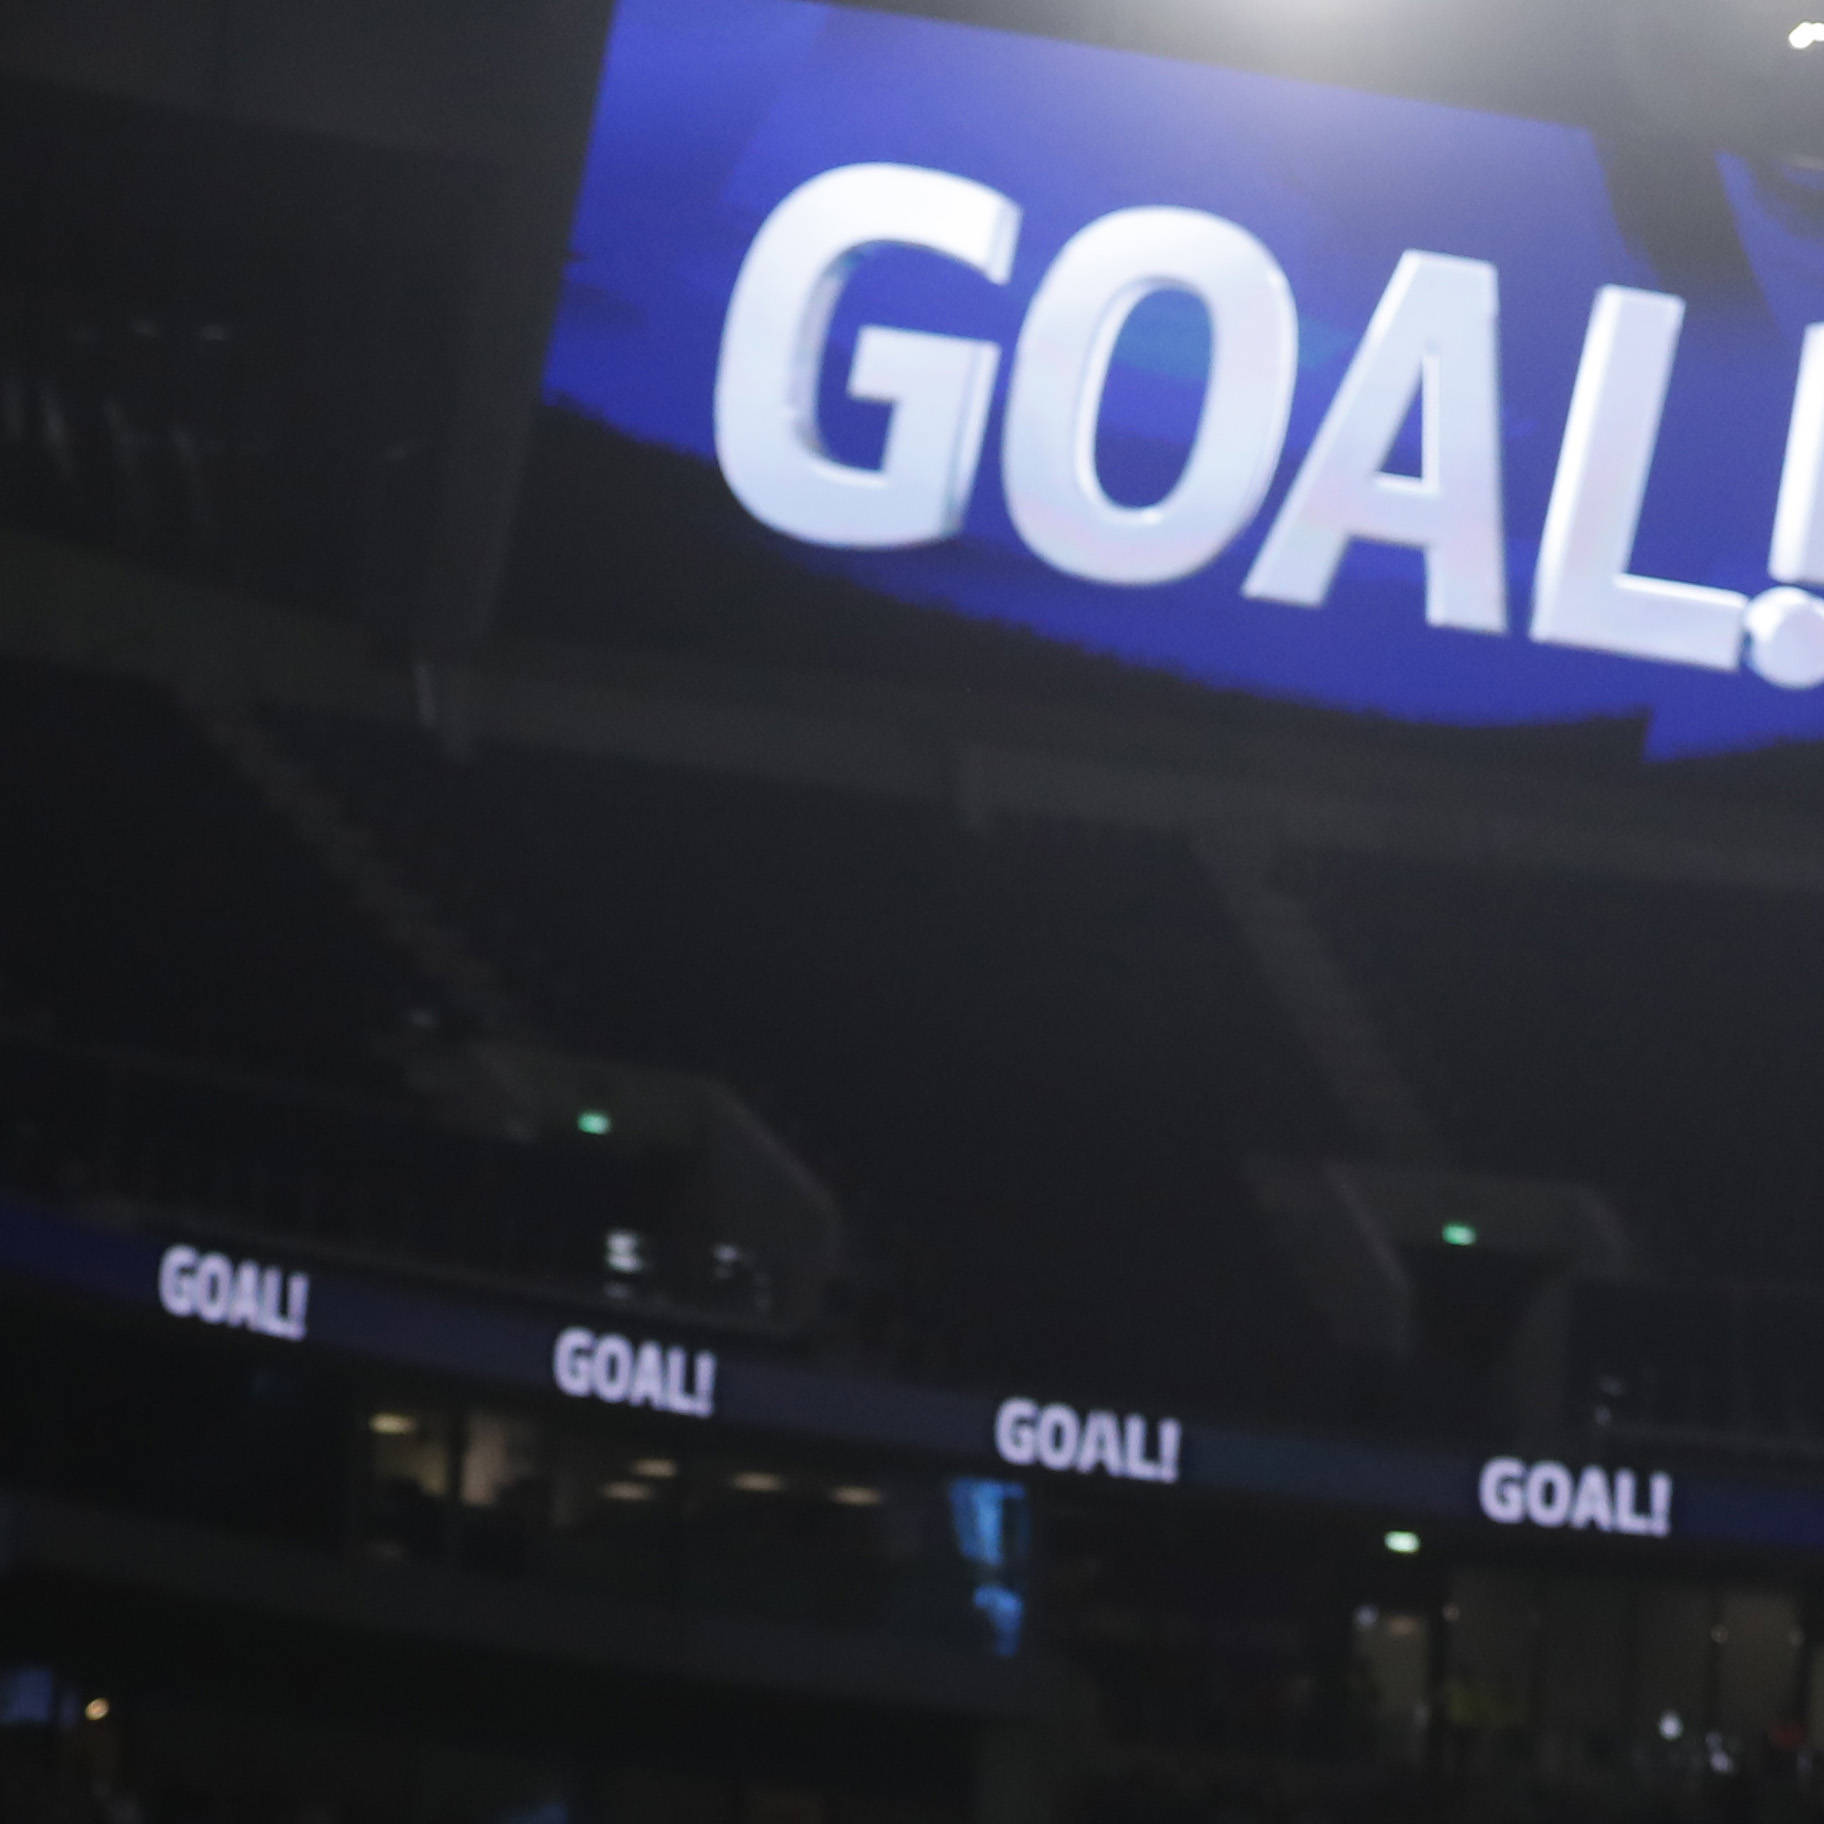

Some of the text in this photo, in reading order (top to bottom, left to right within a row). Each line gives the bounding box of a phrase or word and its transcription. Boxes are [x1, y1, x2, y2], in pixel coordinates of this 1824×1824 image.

[160, 1246, 307, 1339] GOAL!
[555, 1329, 714, 1416] GOAL!
[996, 1398, 1180, 1482] GOAL!
[1480, 1458, 1670, 1535] GOAL!
